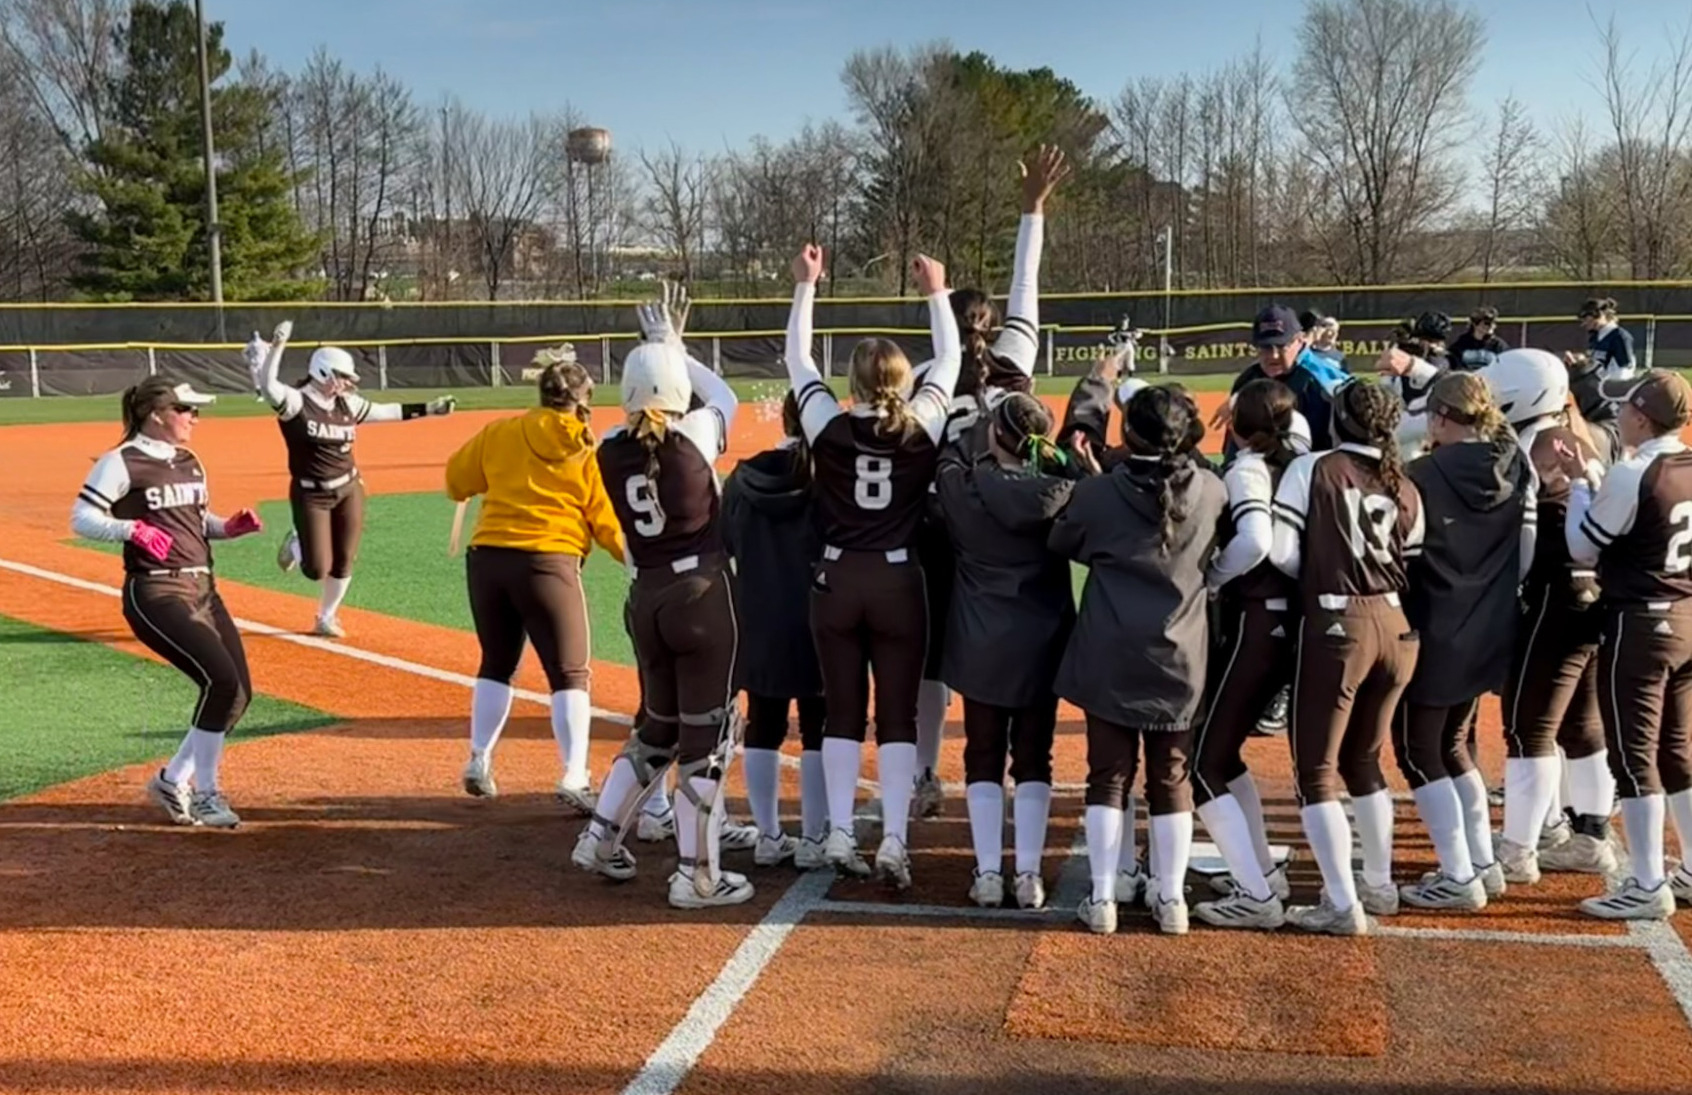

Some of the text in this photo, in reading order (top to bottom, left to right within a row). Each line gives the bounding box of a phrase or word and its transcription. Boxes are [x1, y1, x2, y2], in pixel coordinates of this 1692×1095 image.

[1055, 345, 1158, 362] FIGHTG
[307, 419, 356, 441] SAINT
[145, 482, 208, 510] SAINT
[854, 454, 893, 511] 8
[625, 474, 667, 538] 9
